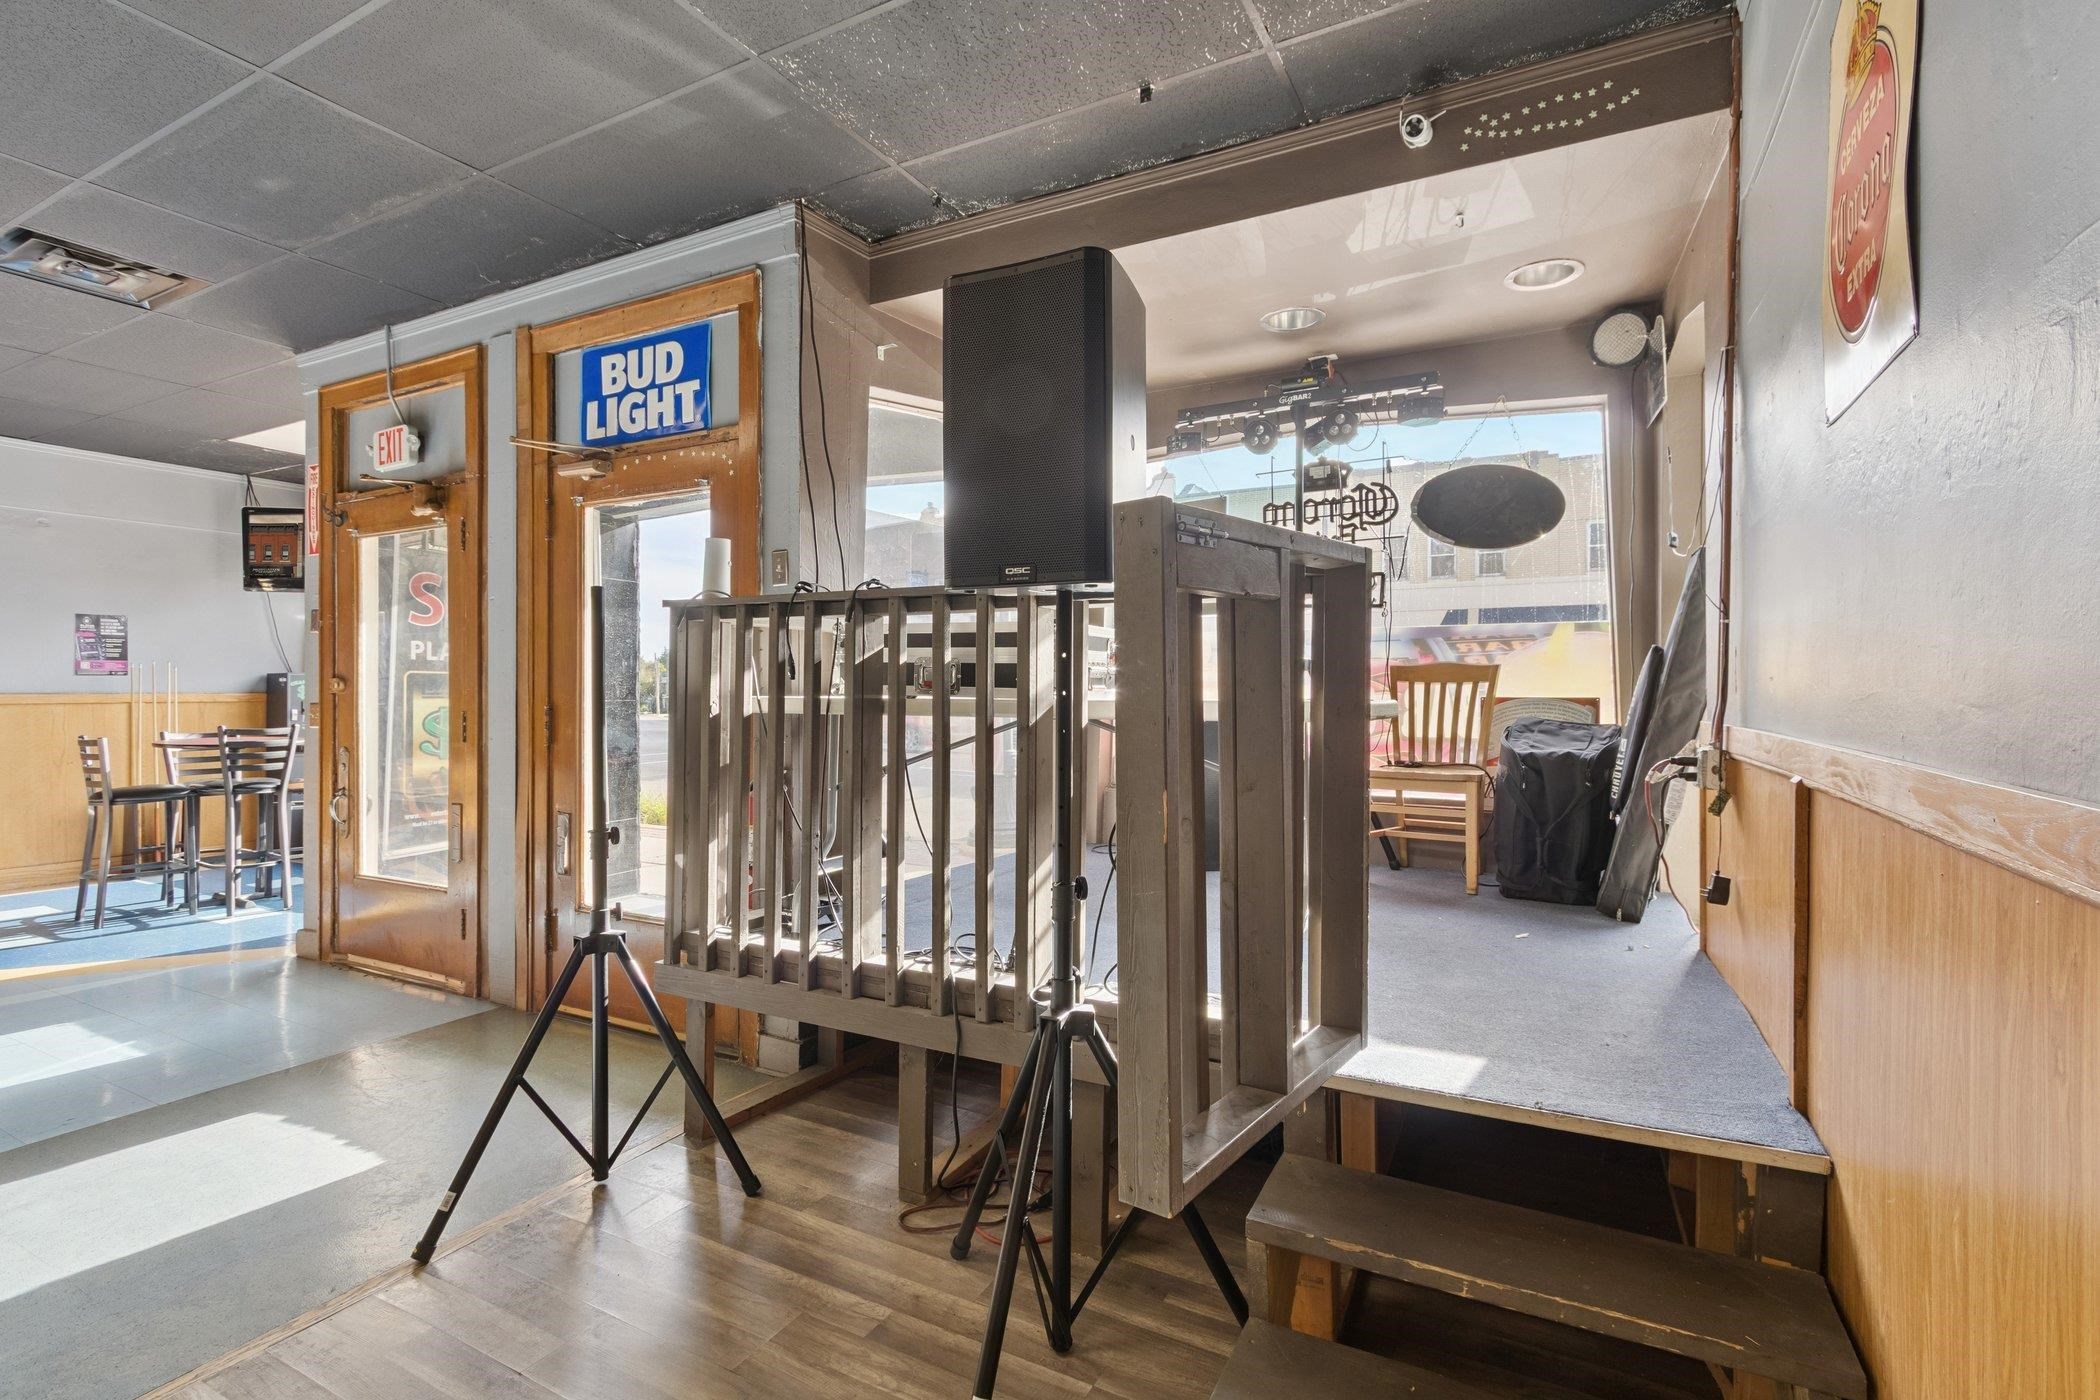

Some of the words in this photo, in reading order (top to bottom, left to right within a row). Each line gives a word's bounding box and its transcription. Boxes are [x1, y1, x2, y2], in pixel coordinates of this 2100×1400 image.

[1839, 72, 1885, 176] CERVEZA
[1834, 132, 1892, 275] Corona
[1846, 238, 1877, 303] EXTRA
[601, 340, 684, 396] BUD
[586, 379, 701, 441] LIGHT
[378, 427, 404, 466] EXIT
[1005, 566, 1031, 575] QSC
